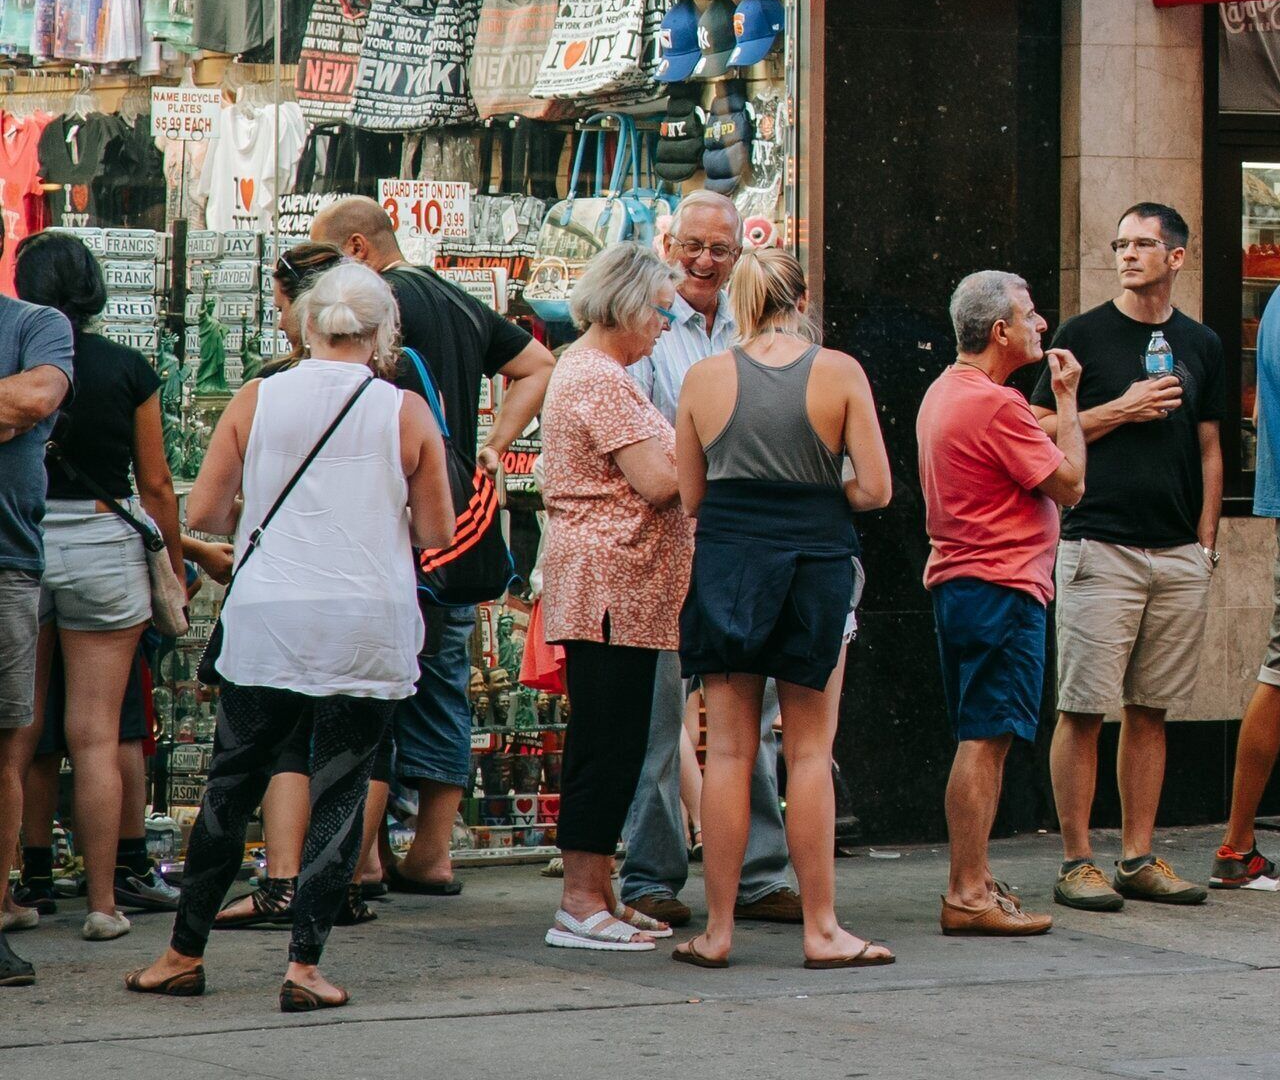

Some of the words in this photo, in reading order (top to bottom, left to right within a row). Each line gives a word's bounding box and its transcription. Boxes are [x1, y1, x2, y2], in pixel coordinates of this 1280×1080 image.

[579, 31, 620, 66] NY
[304, 59, 347, 91] NEW
[154, 92, 179, 102] NAME
[182, 93, 220, 104] BICYCLE
[168, 104, 202, 113] PLATES
[156, 118, 181, 130] $5.99
[185, 118, 212, 132] EACH
[383, 182, 410, 198] GUARD
[413, 183, 429, 198] PET
[431, 183, 442, 198] ON
[445, 184, 467, 199] DUTY
[383, 198, 399, 233] 3
[411, 200, 442, 235] 10
[444, 201, 453, 209] 00
[444, 228, 467, 237] EACH
[107, 238, 154, 253] FRANCIS
[188, 238, 216, 252] HAILEY
[225, 238, 252, 251] JAY
[106, 271, 152, 284] FRANK
[219, 271, 251, 284] JAYDEN
[106, 302, 151, 316] FRED
[108, 334, 154, 347] FRITZ
